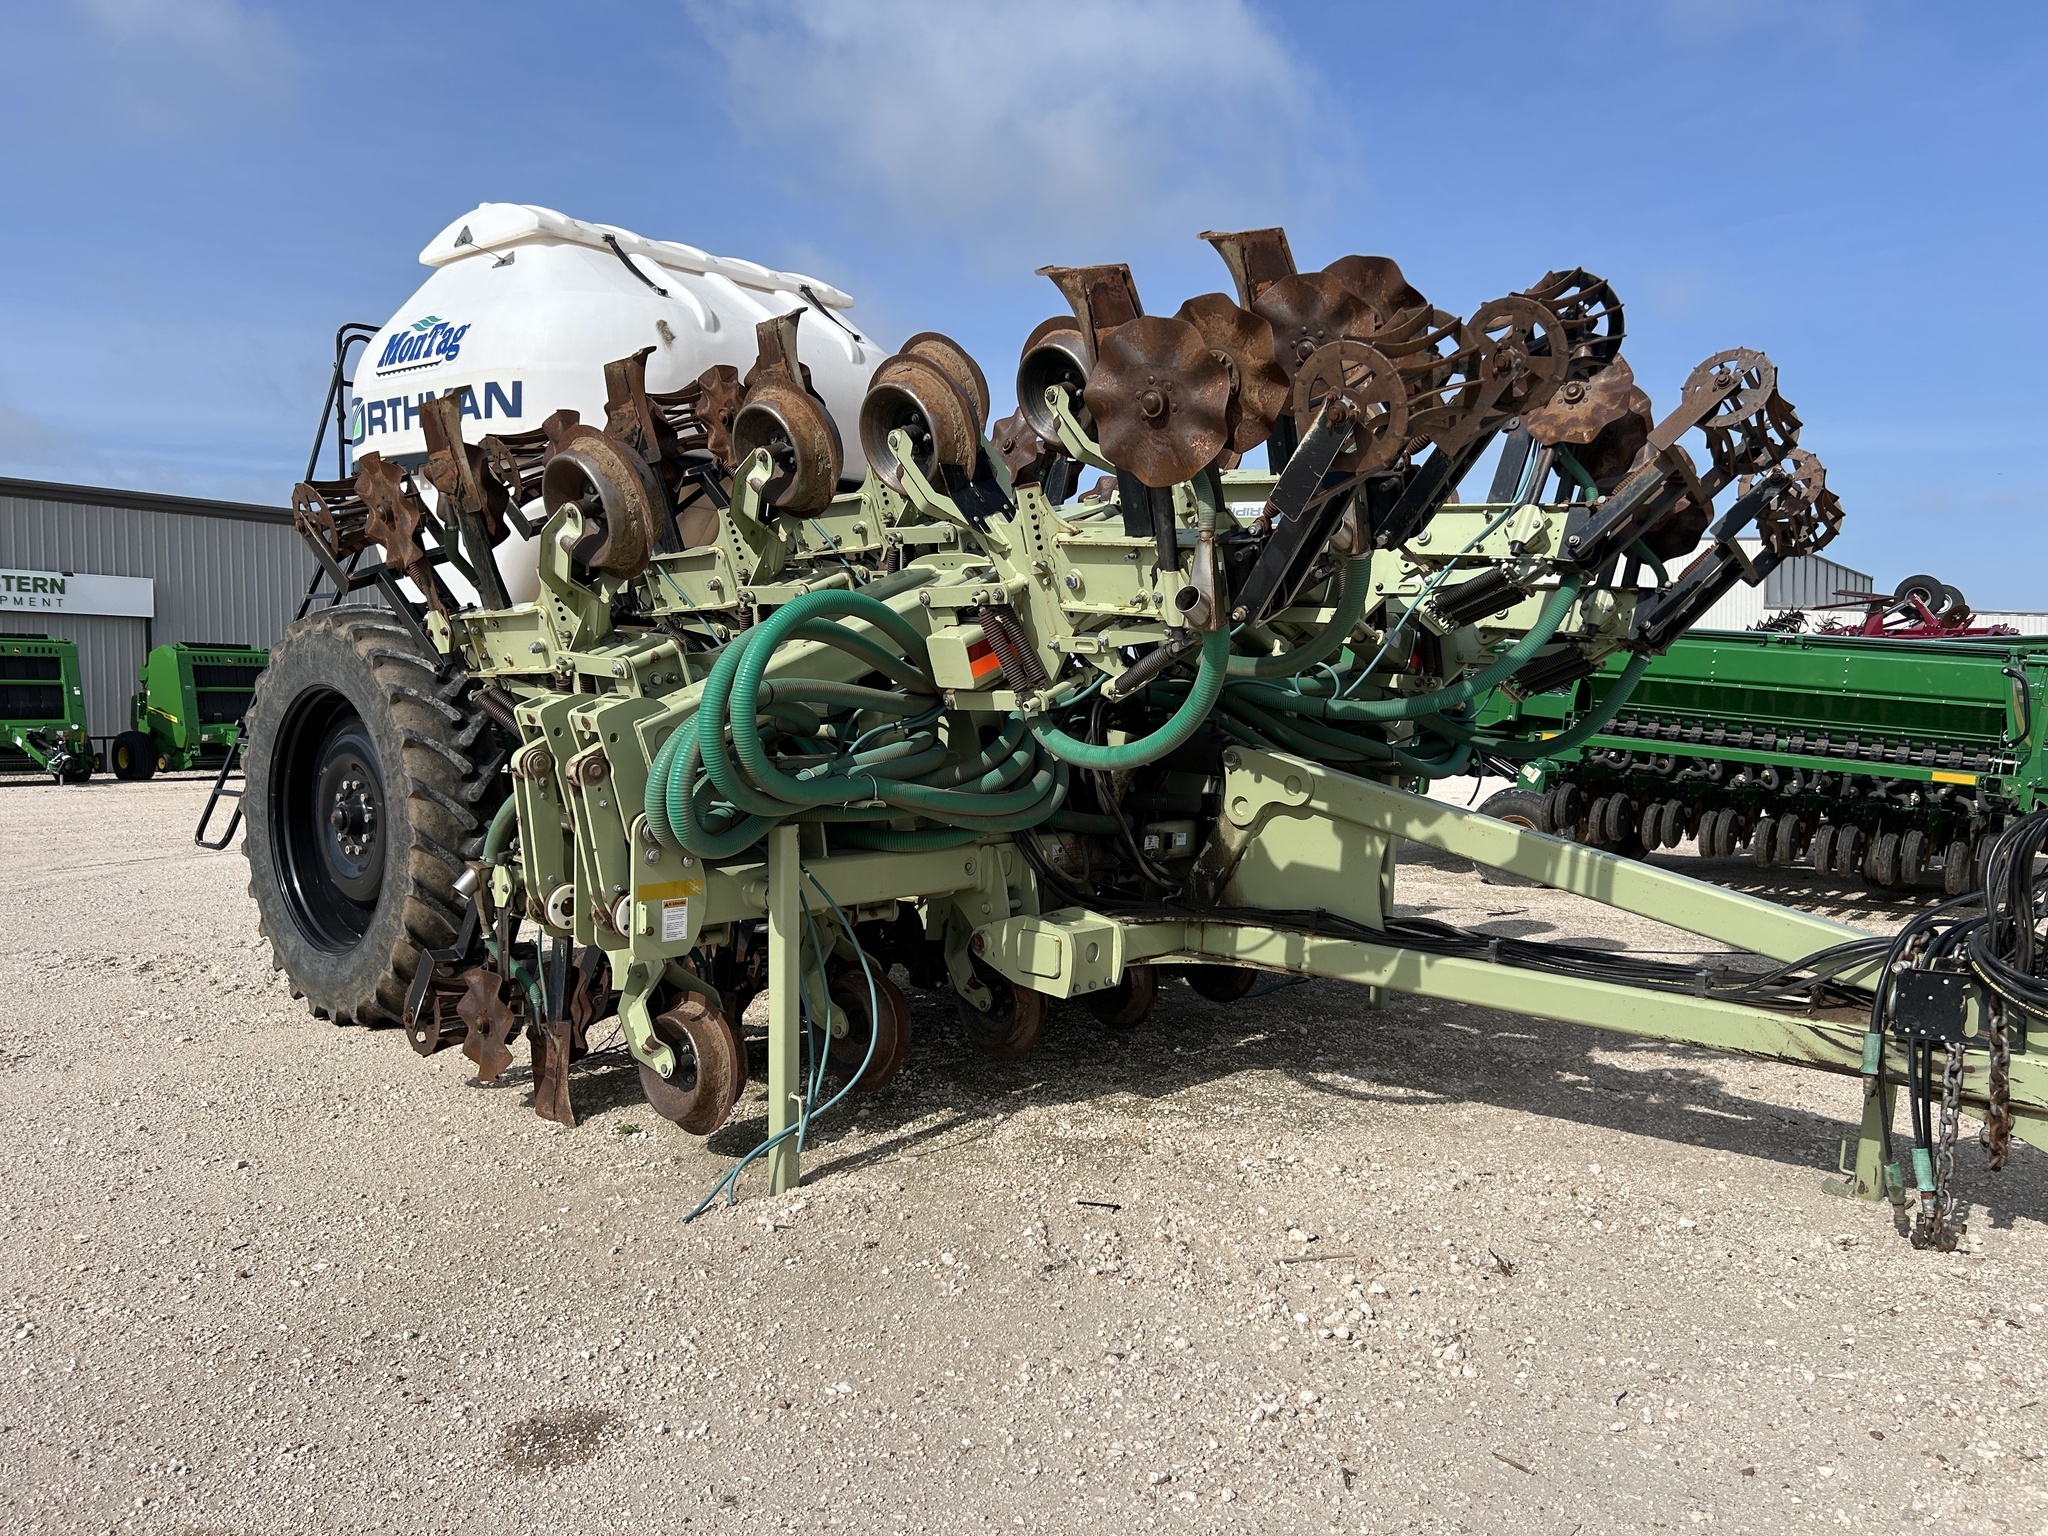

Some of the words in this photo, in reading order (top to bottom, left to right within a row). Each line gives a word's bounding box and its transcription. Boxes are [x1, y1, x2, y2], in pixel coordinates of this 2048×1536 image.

[377, 321, 471, 368] MonTag
[352, 380, 522, 447] ORTHAN
[0, 574, 65, 594] TERN
